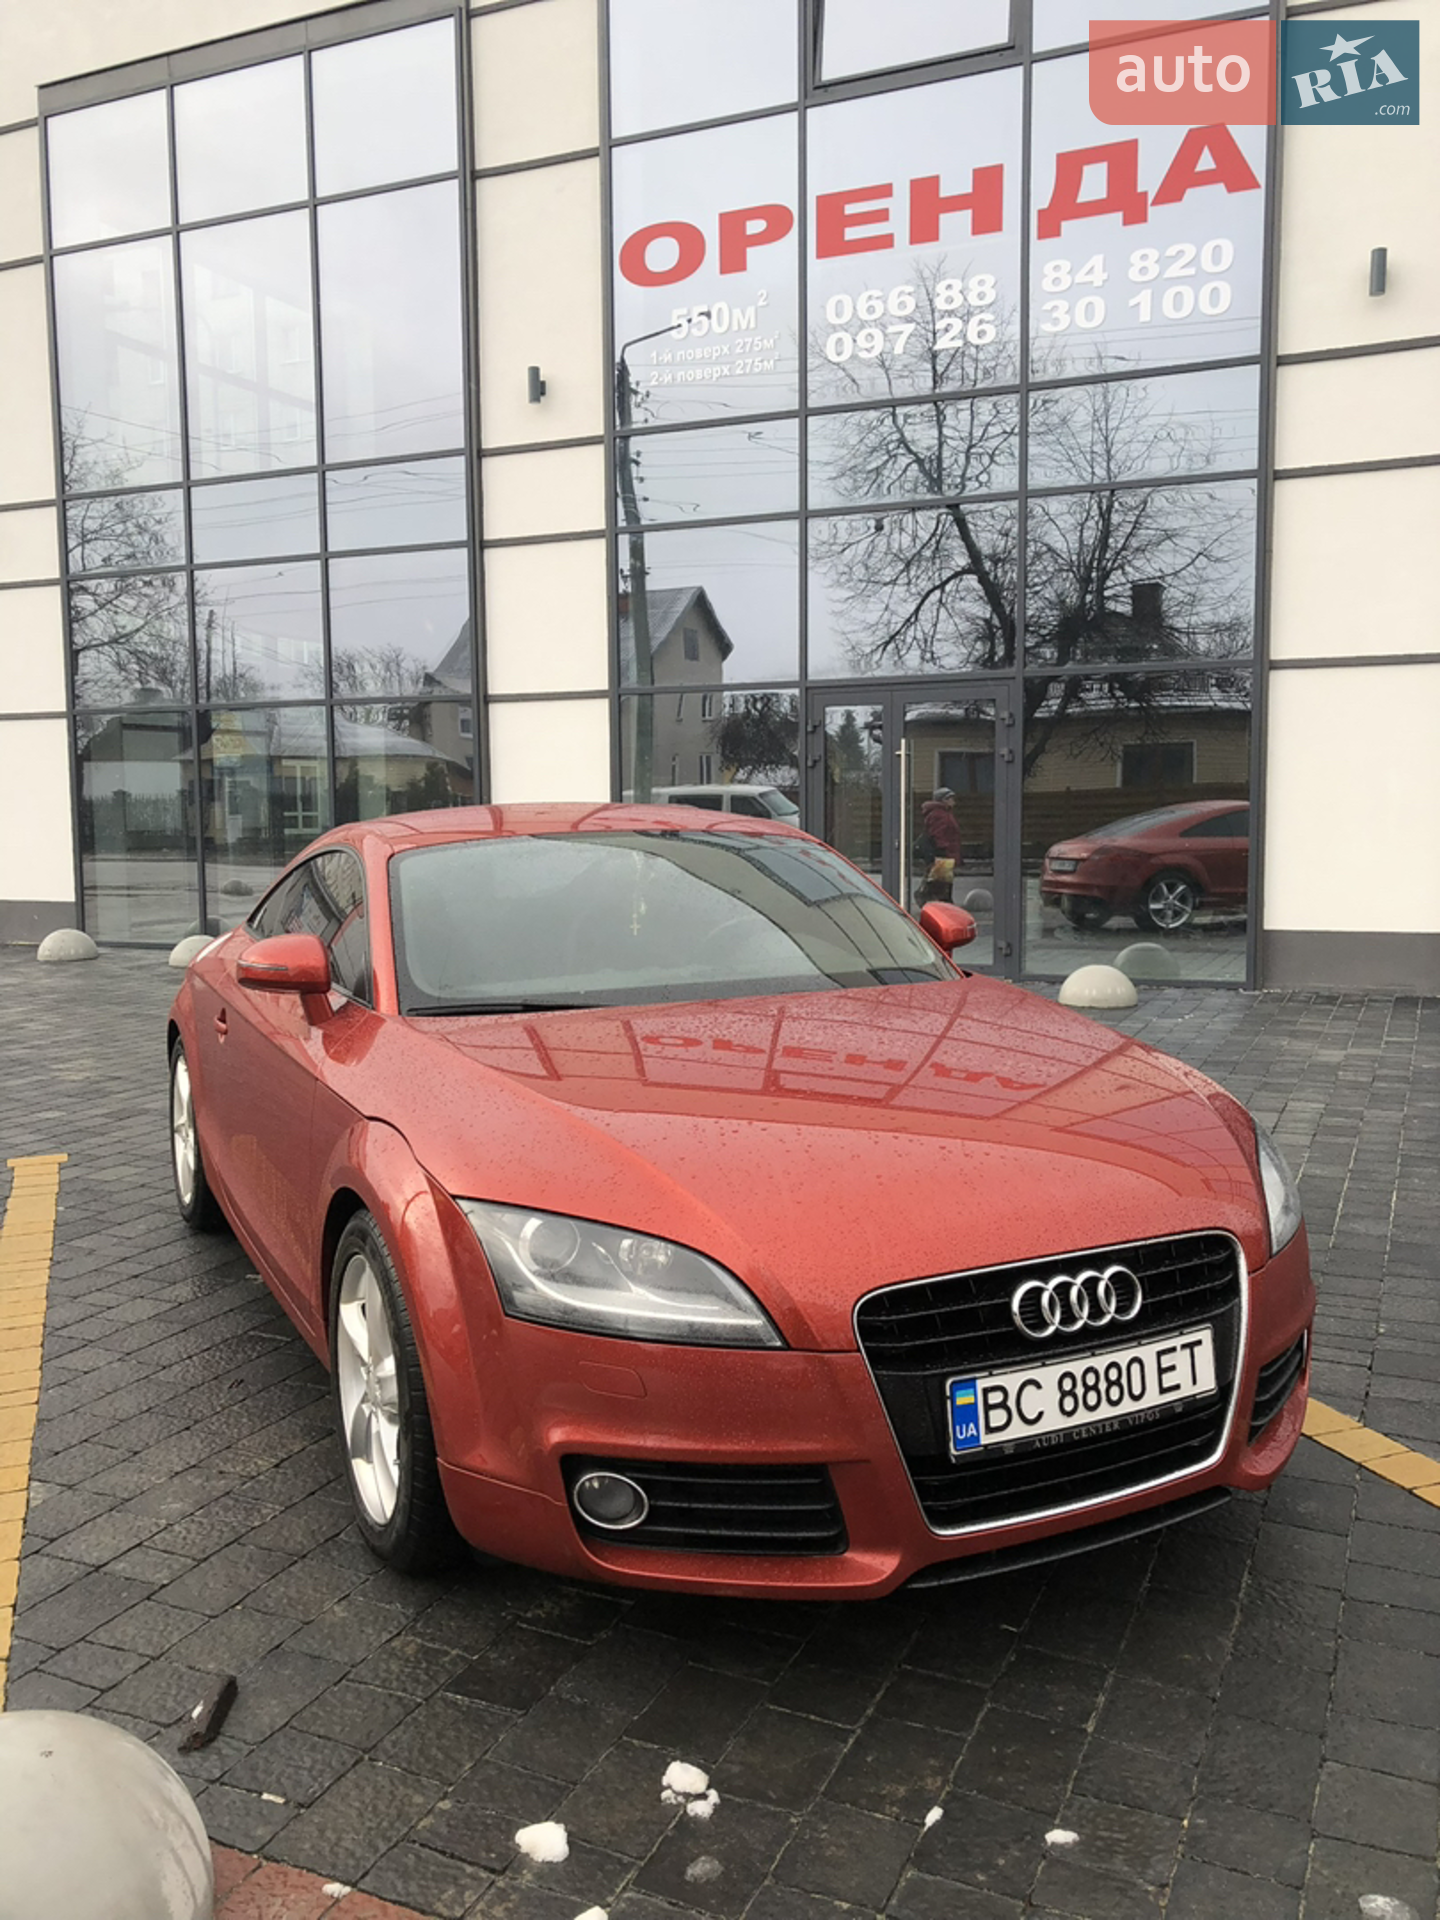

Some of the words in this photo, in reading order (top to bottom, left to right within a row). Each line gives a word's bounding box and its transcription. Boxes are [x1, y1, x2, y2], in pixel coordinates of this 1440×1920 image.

[618, 122, 1262, 288] ОРЕНДА
[826, 285, 916, 325] 066
[935, 273, 997, 311] 88
[1042, 254, 1107, 292] 84
[1127, 238, 1235, 283] 820
[826, 322, 916, 363] 097
[934, 312, 997, 350] 26
[1042, 295, 1106, 332] 30
[1127, 280, 1233, 323] 100
[650, 370, 673, 386] 2-й
[677, 364, 731, 381] поверх
[651, 348, 673, 366] 1-й
[676, 346, 731, 362] поверх
[982, 1377, 1045, 1436] BC
[1057, 1356, 1147, 1418] 8880
[1156, 1339, 1204, 1396] ET
[955, 1422, 979, 1440] UA
[1033, 1432, 1066, 1448] AUDI
[1072, 1420, 1121, 1440] CENTER
